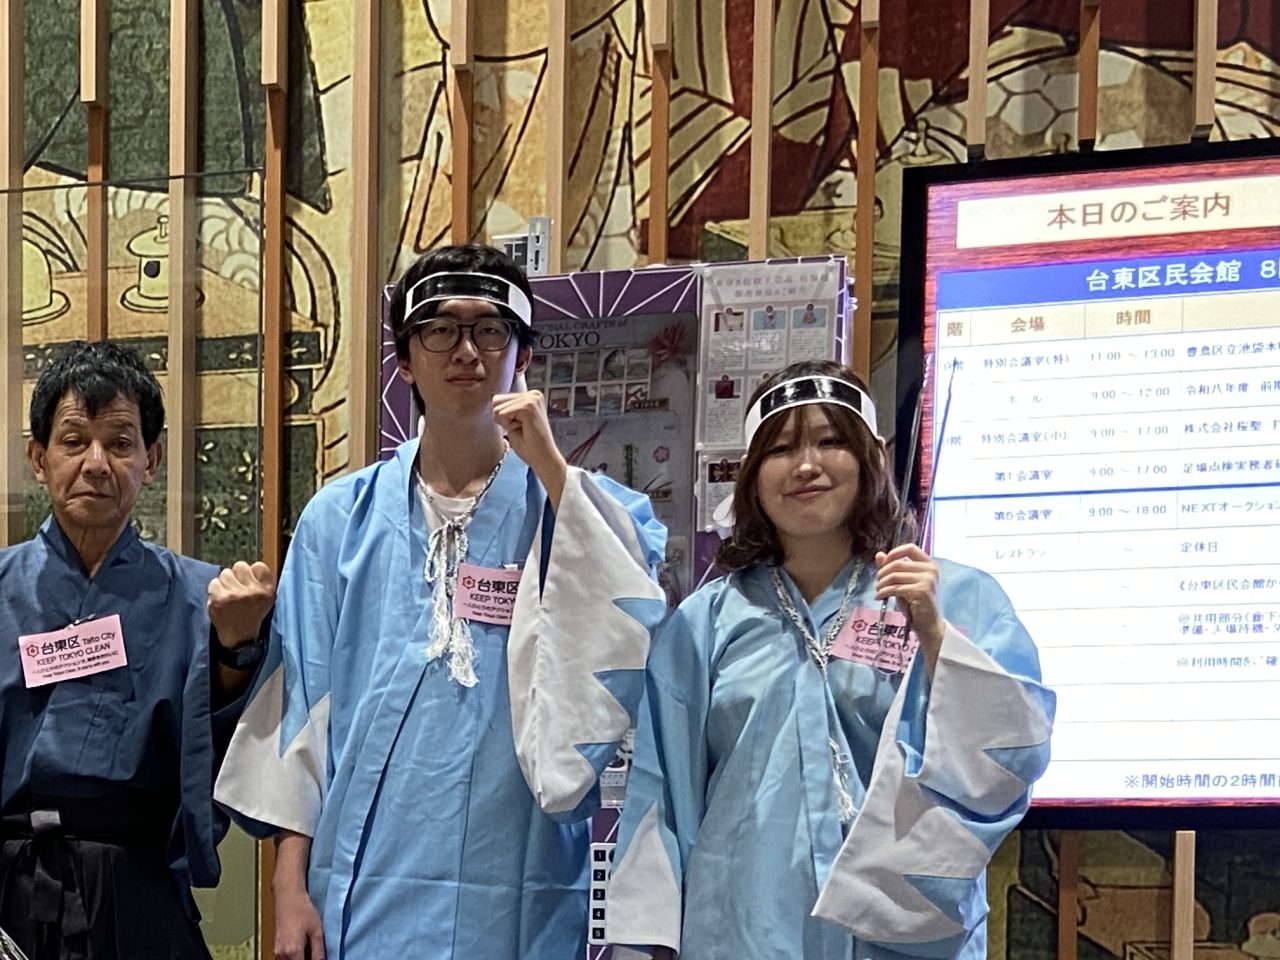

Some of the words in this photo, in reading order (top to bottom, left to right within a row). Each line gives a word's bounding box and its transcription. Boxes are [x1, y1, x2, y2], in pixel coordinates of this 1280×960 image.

[1047, 192, 1231, 231] 本日のご案内
[1086, 260, 1241, 291] 台東区民会館
[1260, 259, 1280, 279] 8
[1010, 315, 1044, 332] 会場
[1116, 309, 1151, 326] 時間
[947, 320, 963, 337] 階
[539, 332, 600, 349] OKYO
[1181, 542, 1218, 553] 定休日
[470, 594, 490, 603] KEEP
[493, 596, 516, 605] TOKY
[41, 635, 80, 655] 台東区
[82, 636, 100, 645] Taito
[101, 631, 116, 641] City
[37, 657, 57, 666] KEEP
[59, 649, 85, 661] TOKYO
[85, 643, 111, 655] CLEAN
[1124, 774, 1280, 789] ※開始時間の2時間
